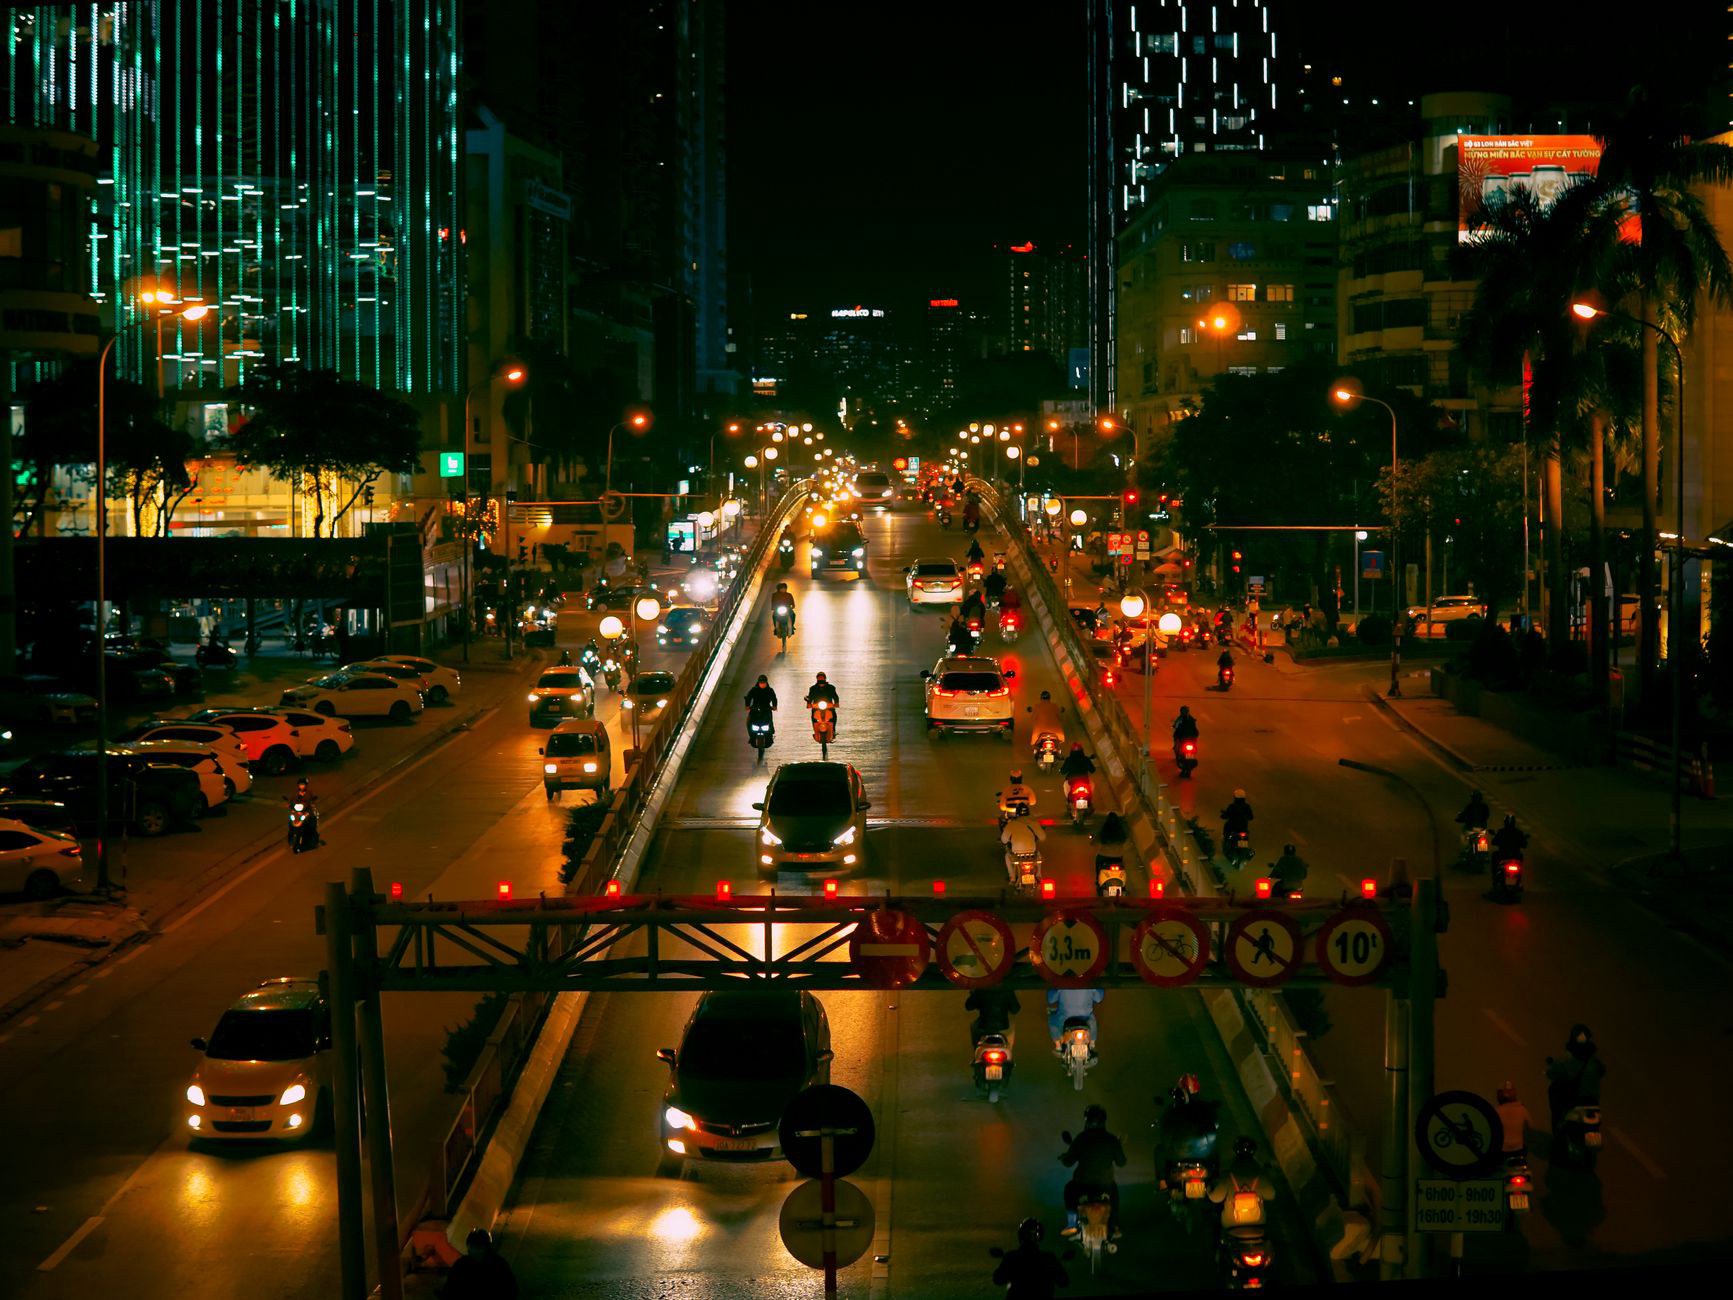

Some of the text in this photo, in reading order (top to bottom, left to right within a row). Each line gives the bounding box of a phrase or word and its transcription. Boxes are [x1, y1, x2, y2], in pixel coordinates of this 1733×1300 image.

[1050, 936, 1091, 965] 3,3m
[1426, 1187, 1455, 1201] 6h00
[1466, 1187, 1495, 1202] 9h00
[1418, 1209, 1454, 1223] 16h00
[1466, 1209, 1501, 1224] 19h30
